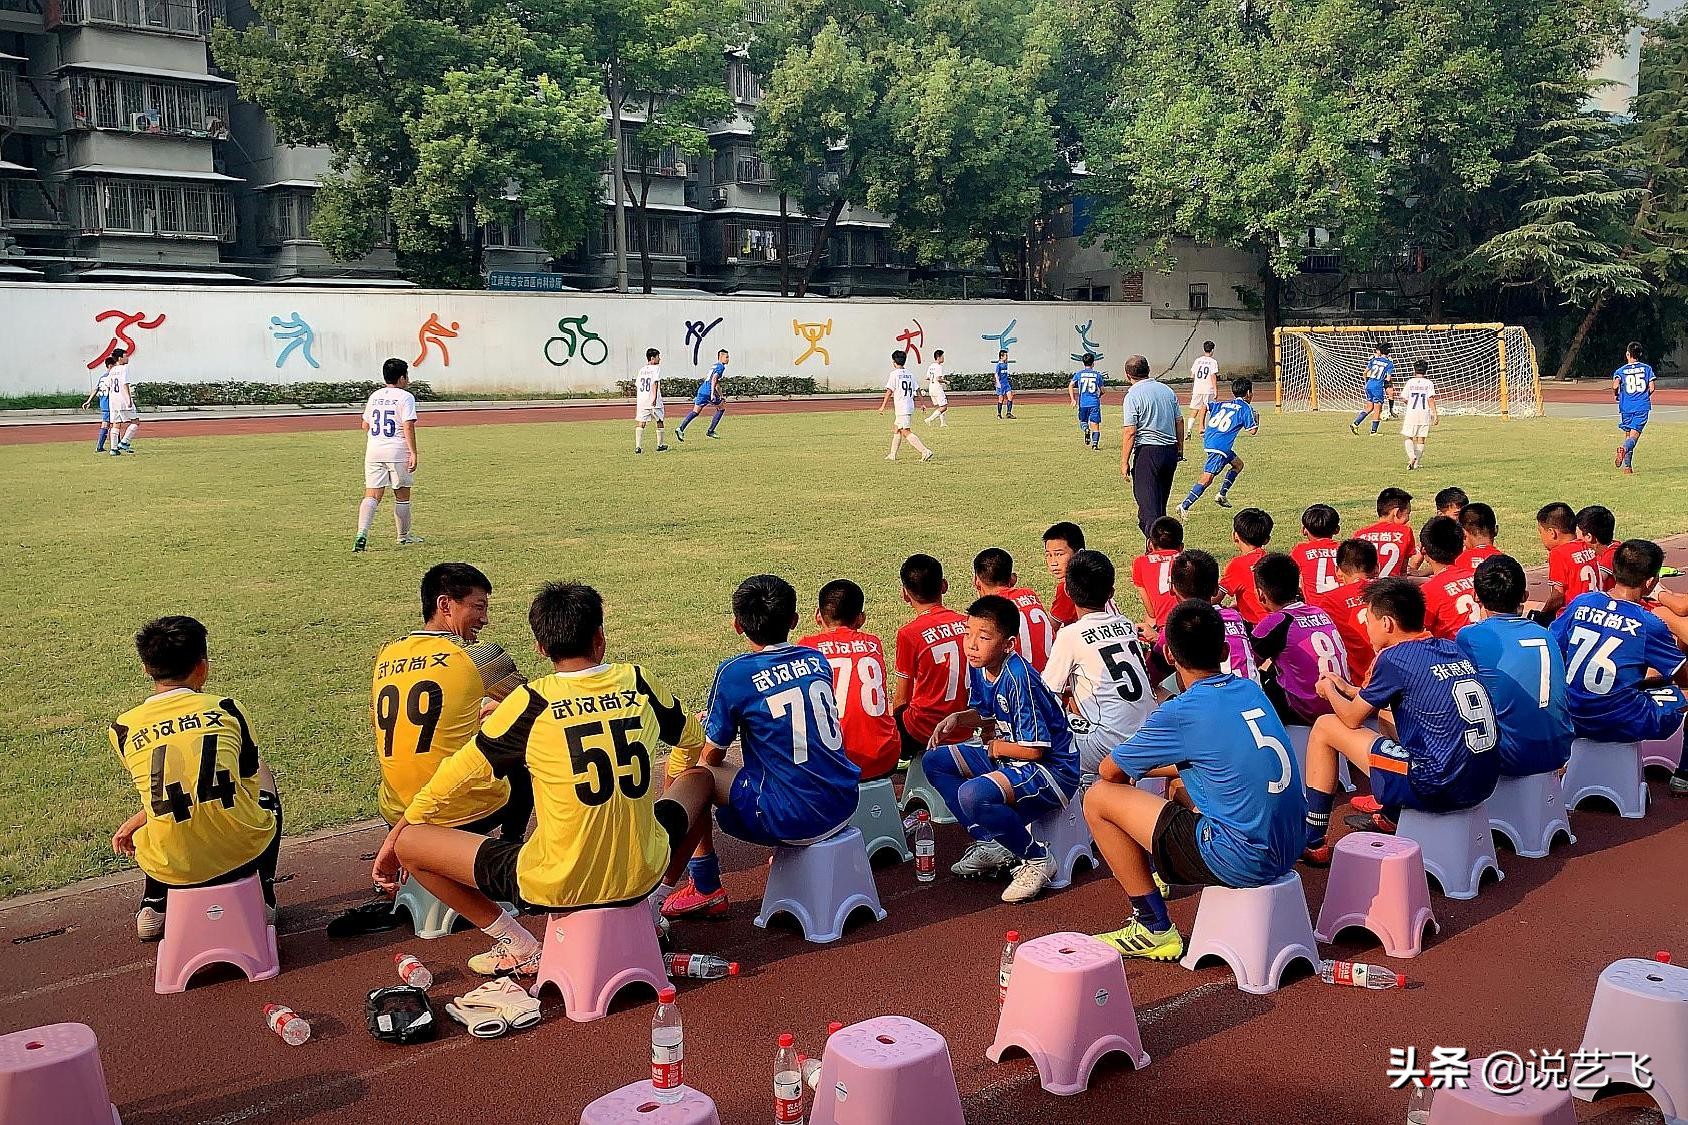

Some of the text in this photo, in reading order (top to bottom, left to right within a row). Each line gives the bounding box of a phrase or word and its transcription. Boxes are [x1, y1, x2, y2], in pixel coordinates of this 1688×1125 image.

[1081, 377, 1096, 393] 75
[1197, 366, 1210, 380] 69
[1626, 373, 1646, 393] 85
[1411, 393, 1427, 409] 71
[372, 409, 396, 437] 35
[1316, 557, 1340, 594] 4
[1014, 595, 1043, 609] 尚文
[922, 620, 969, 644] 武汉尚
[1081, 621, 1137, 645] 武汉尚文
[1574, 606, 1642, 636] 武汉尚文
[818, 640, 881, 655] 武汉尚文
[1566, 625, 1624, 695] 76
[378, 652, 450, 680] 武汉尚文
[752, 656, 824, 692] 武汉尚文
[931, 640, 970, 702] 7
[1518, 638, 1551, 708] 7
[551, 690, 641, 720] 武汉尚文
[828, 656, 886, 718] 78
[131, 710, 225, 751] 武汉尚文
[377, 680, 444, 757] 99
[766, 680, 843, 765] 70
[1451, 678, 1497, 754] 9
[564, 716, 650, 806] 55
[1240, 707, 1292, 794] 5
[150, 733, 237, 824] 44
